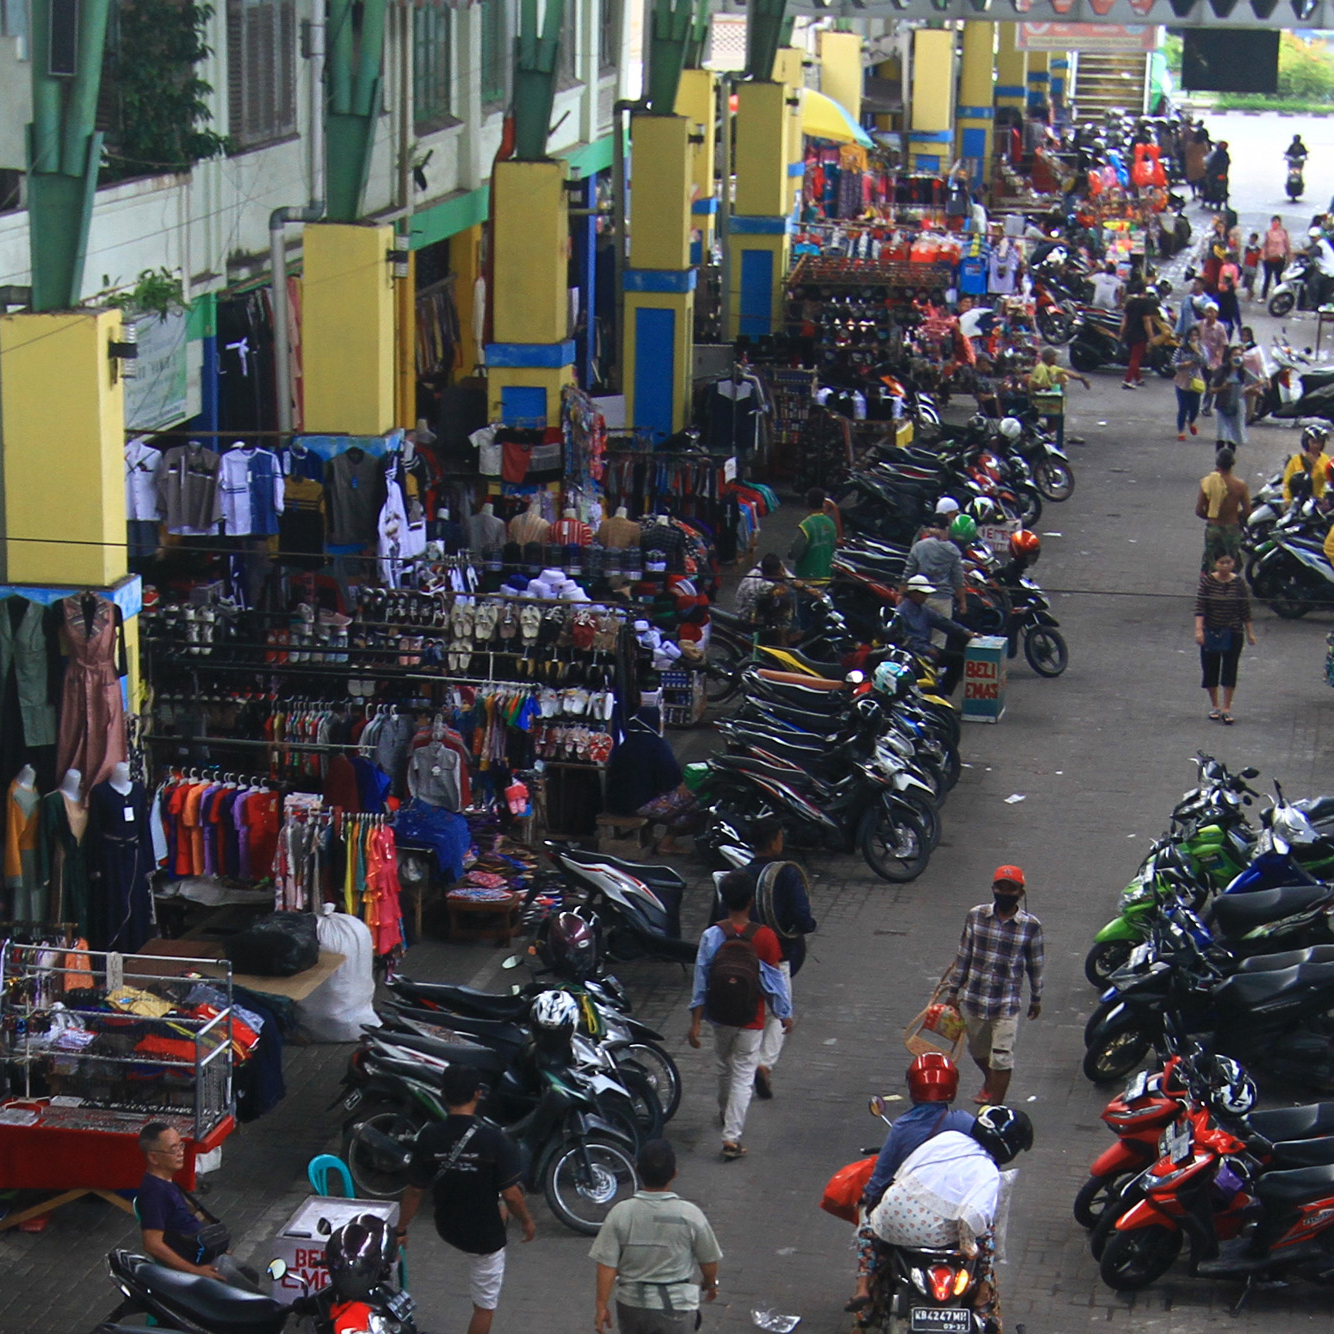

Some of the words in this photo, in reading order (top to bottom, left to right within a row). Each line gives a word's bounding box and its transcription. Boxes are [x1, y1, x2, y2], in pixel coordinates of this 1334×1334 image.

[966, 660, 996, 679] BELI
[965, 682, 999, 699] EMAS
[295, 1249, 328, 1269] BEL
